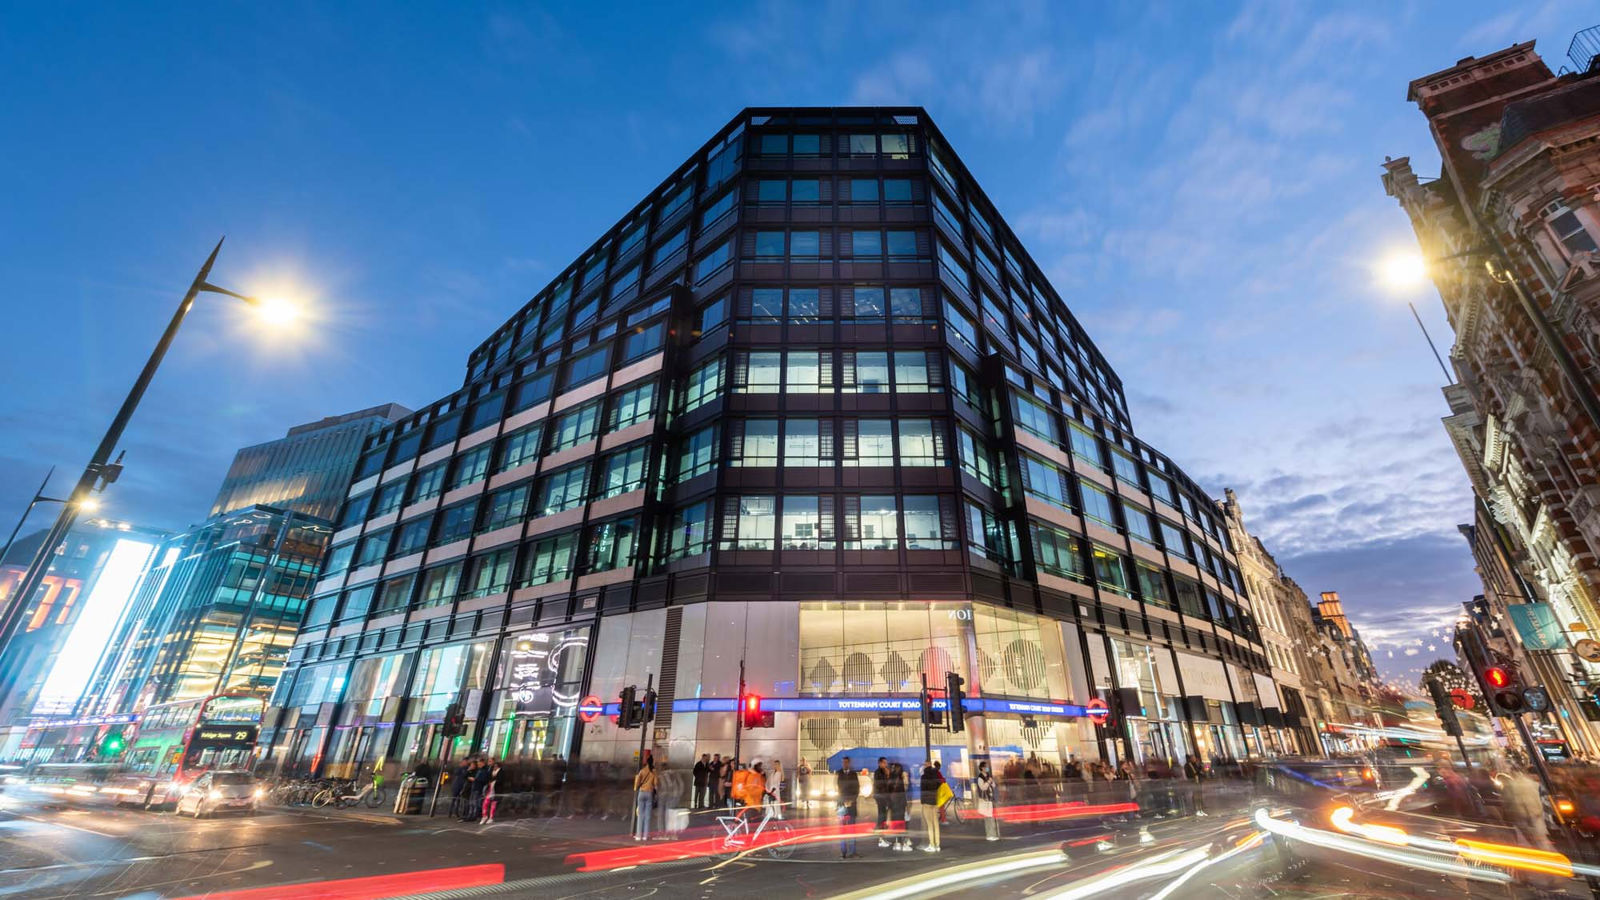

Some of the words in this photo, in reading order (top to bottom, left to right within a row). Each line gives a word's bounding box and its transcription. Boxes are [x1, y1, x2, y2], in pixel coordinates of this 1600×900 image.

[838, 701, 878, 709] TOTTENHAM
[879, 701, 901, 709] COURT
[902, 701, 921, 709] ROAD
[235, 732, 247, 741] 29
